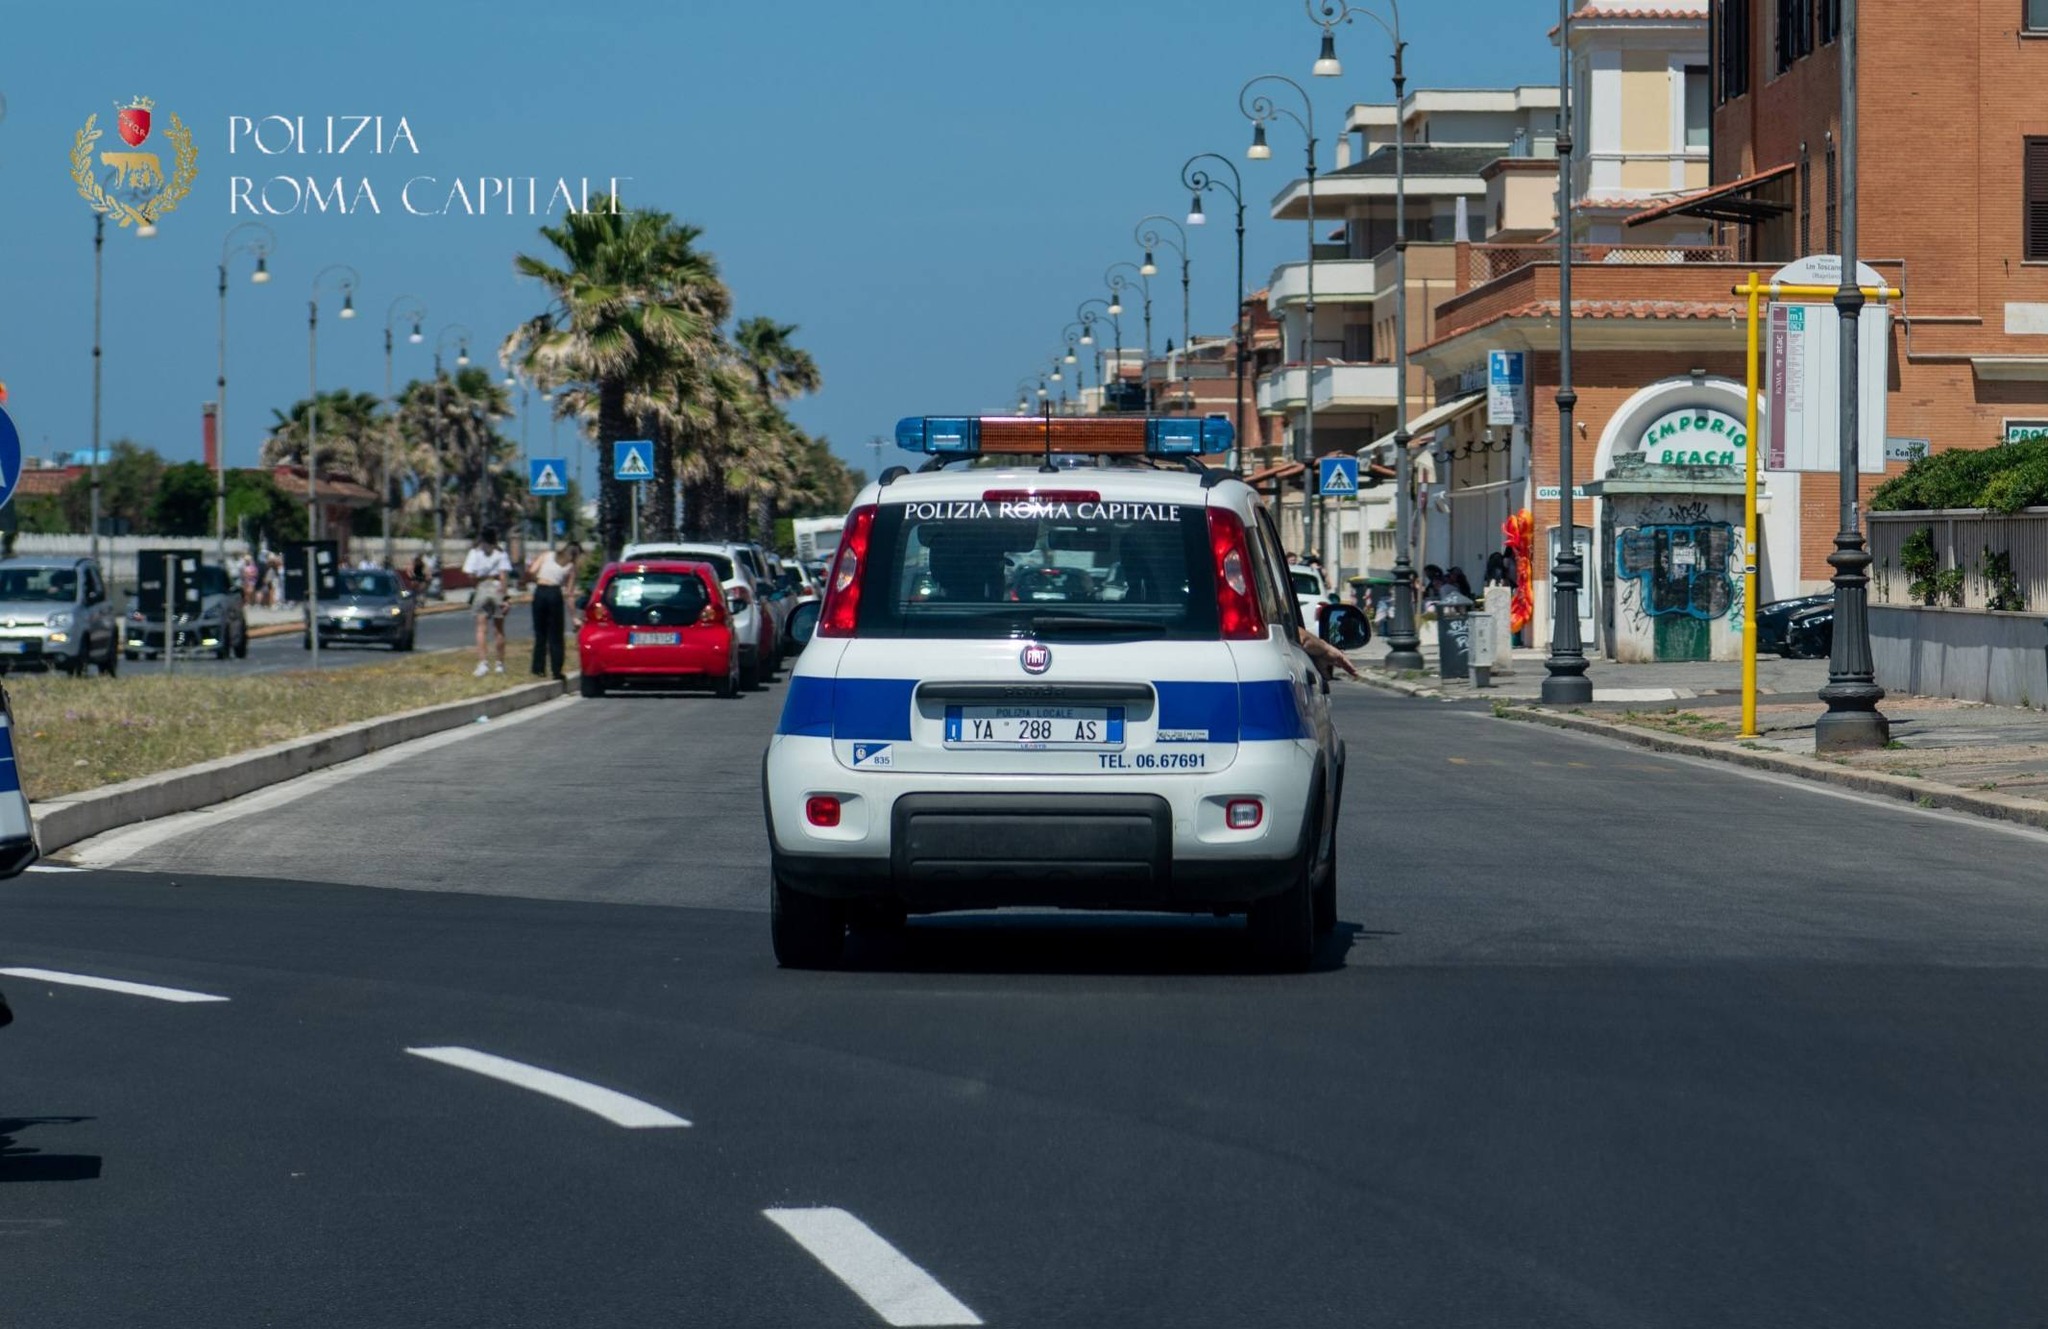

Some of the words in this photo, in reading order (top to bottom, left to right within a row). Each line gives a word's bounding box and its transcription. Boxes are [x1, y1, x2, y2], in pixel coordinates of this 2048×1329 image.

[1647, 416, 1747, 447] EMPORIO
[1661, 450, 1734, 465] BEACH
[904, 502, 992, 520] POLIZIA
[1000, 502, 1071, 520] ROMA
[1077, 503, 1181, 522] CAPITALE
[1027, 650, 1045, 664] FIAT
[996, 708, 1030, 718] POLIZIA
[1037, 709, 1073, 718] LOCALE
[973, 719, 993, 740] YA
[1019, 719, 1052, 740] 288
[1075, 720, 1097, 740] AS
[874, 756, 890, 765] 835
[1099, 754, 1131, 768] TEL.
[1136, 753, 1205, 768] 06.67691
